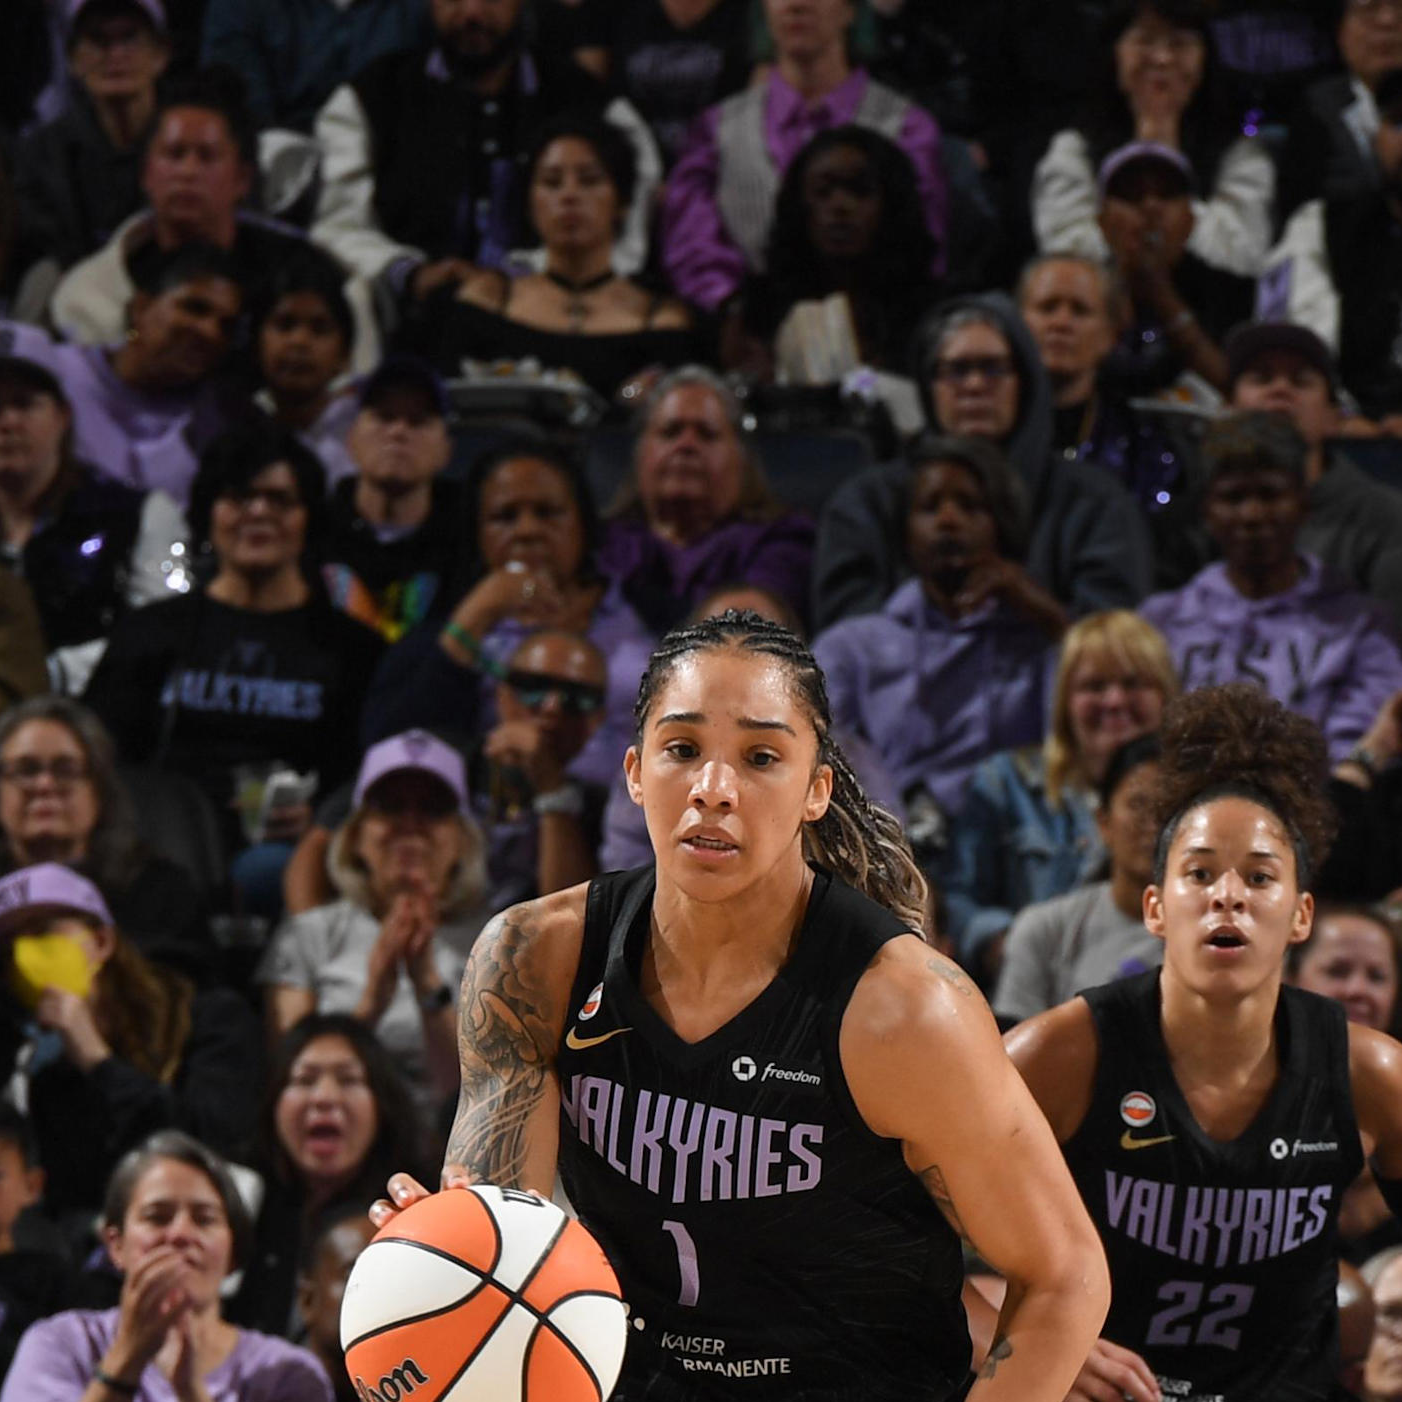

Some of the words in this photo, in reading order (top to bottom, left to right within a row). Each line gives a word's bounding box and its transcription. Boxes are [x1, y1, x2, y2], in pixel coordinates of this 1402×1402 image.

[761, 1062, 822, 1086] freedom
[562, 1074, 825, 1204] VALKYRIES
[1292, 1139, 1339, 1157] freedom
[1105, 1169, 1333, 1269] VALKYRIES
[661, 1220, 701, 1307] 1
[1145, 1280, 1256, 1351] 22
[661, 1332, 726, 1357] KAISER
[676, 1357, 791, 1378] RMANENTE
[1159, 1376, 1193, 1397] AISER
